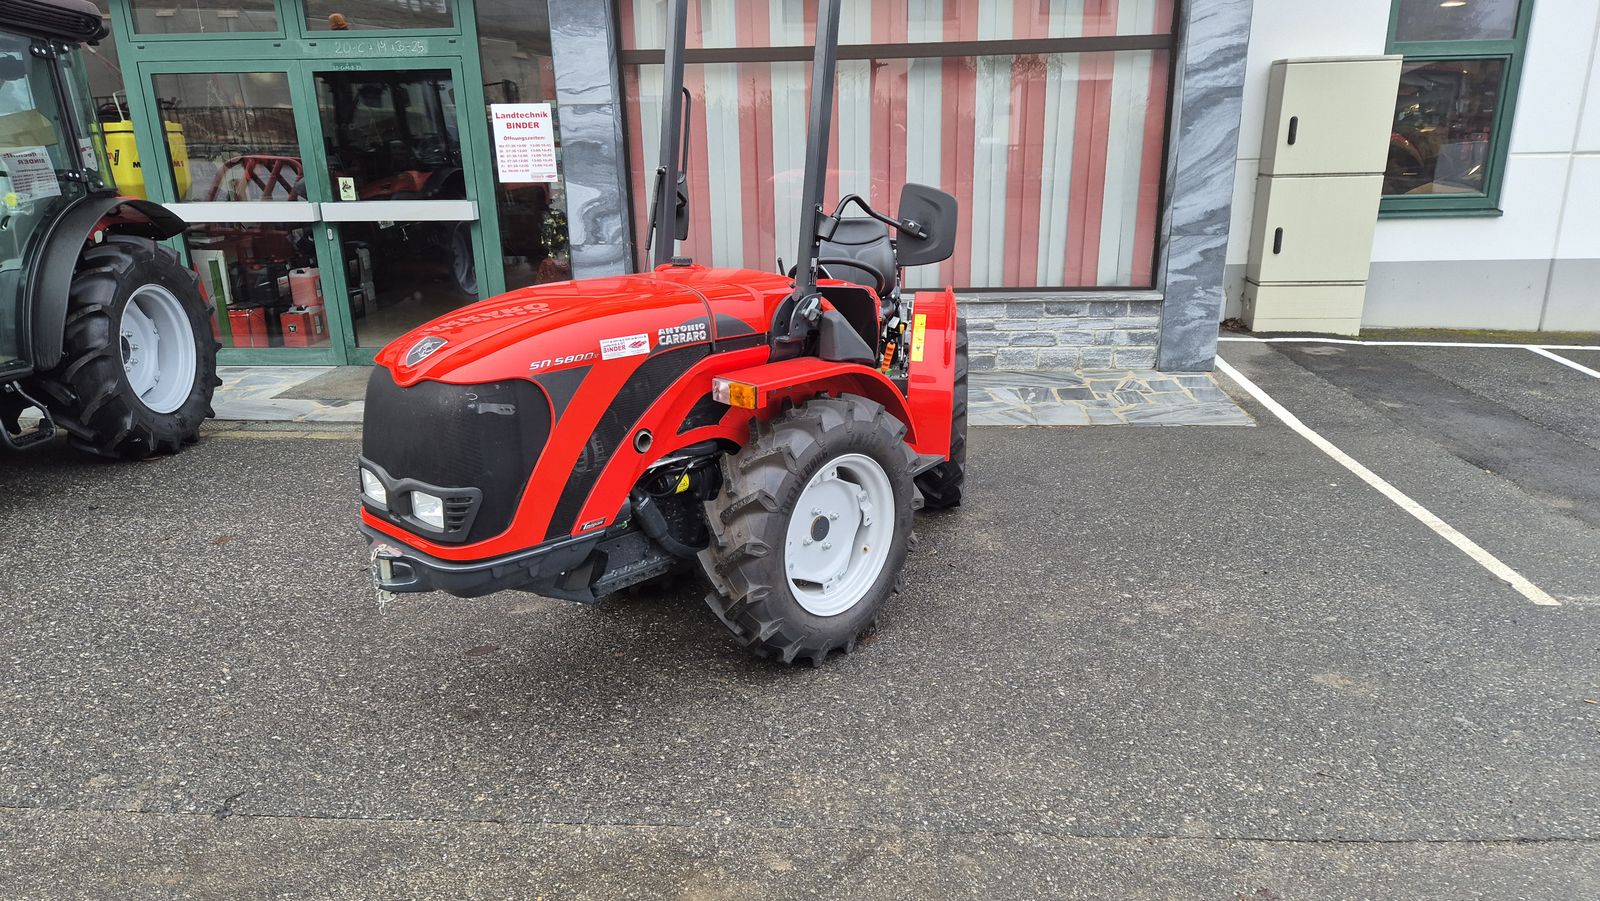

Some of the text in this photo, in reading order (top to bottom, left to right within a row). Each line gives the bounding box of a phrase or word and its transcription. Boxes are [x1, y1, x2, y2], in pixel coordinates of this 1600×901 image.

[657, 323, 706, 335] ANTONIO
[658, 331, 707, 346] CARRARO
[603, 344, 626, 353] BINDER
